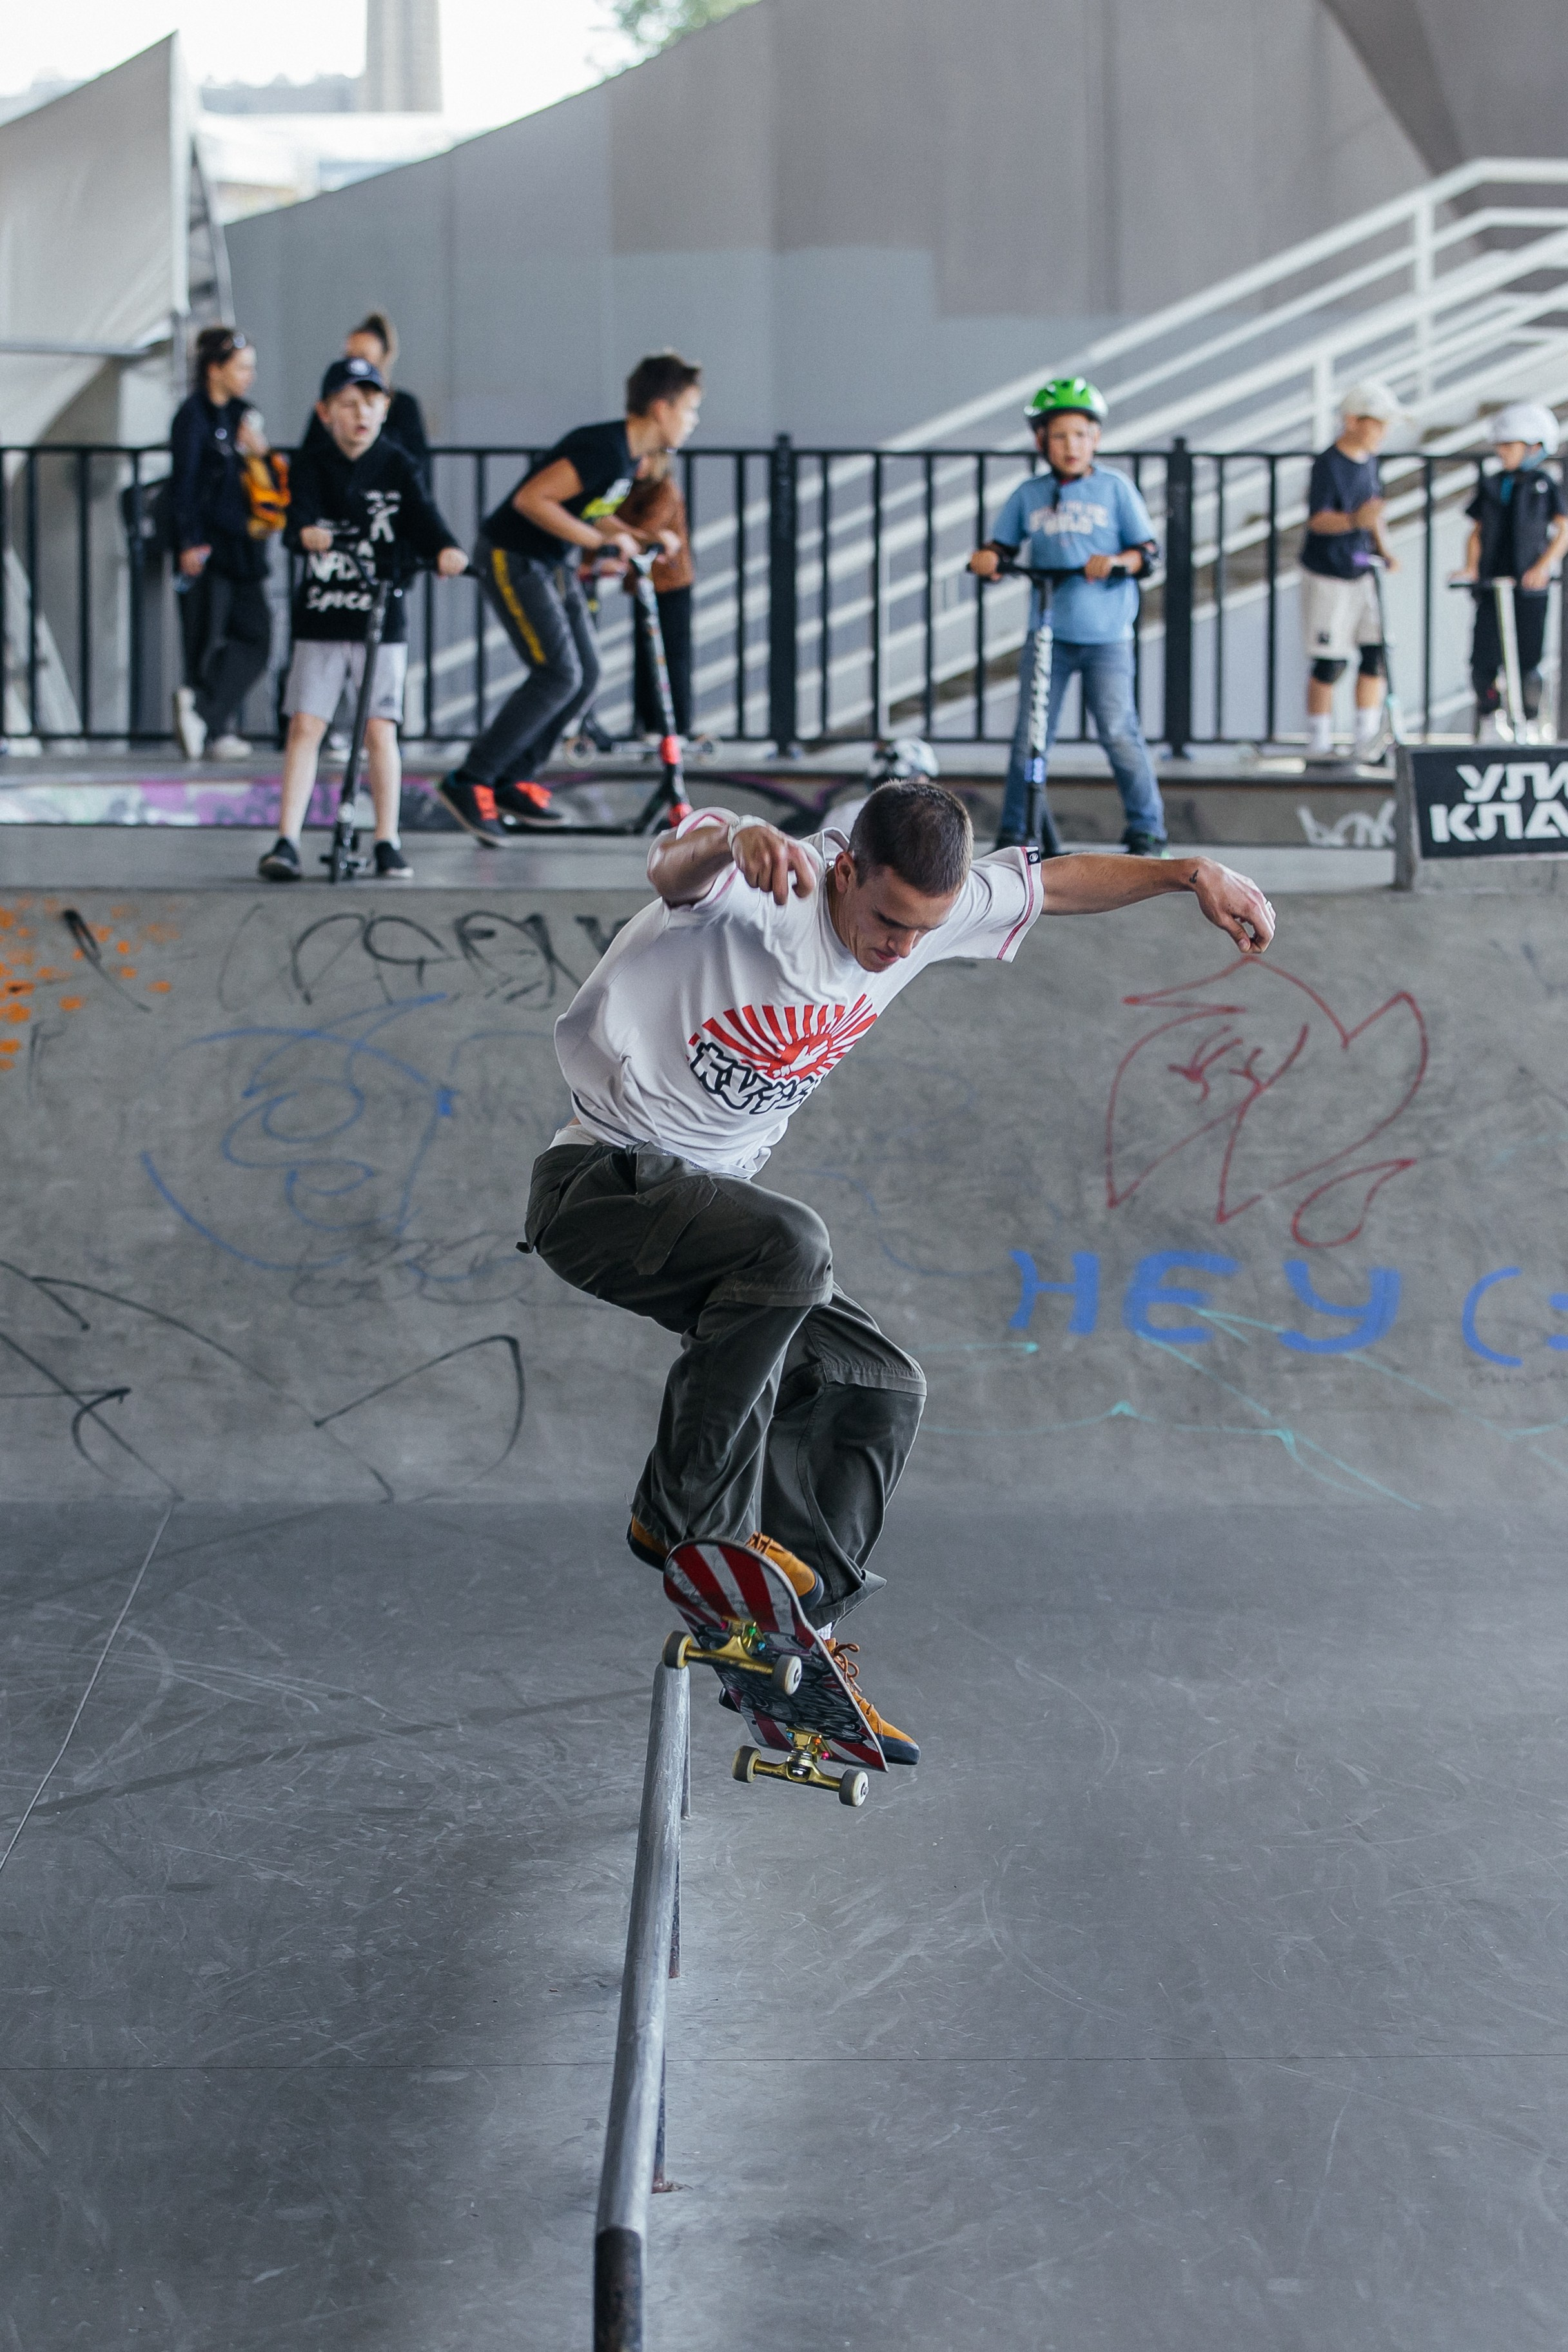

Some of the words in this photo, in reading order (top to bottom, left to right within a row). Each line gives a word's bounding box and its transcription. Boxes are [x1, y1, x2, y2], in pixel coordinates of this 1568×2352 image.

[1455, 761, 1568, 804] УЛИ
[1429, 799, 1568, 843] КЛА
[1010, 1250, 1400, 1353] HEY
